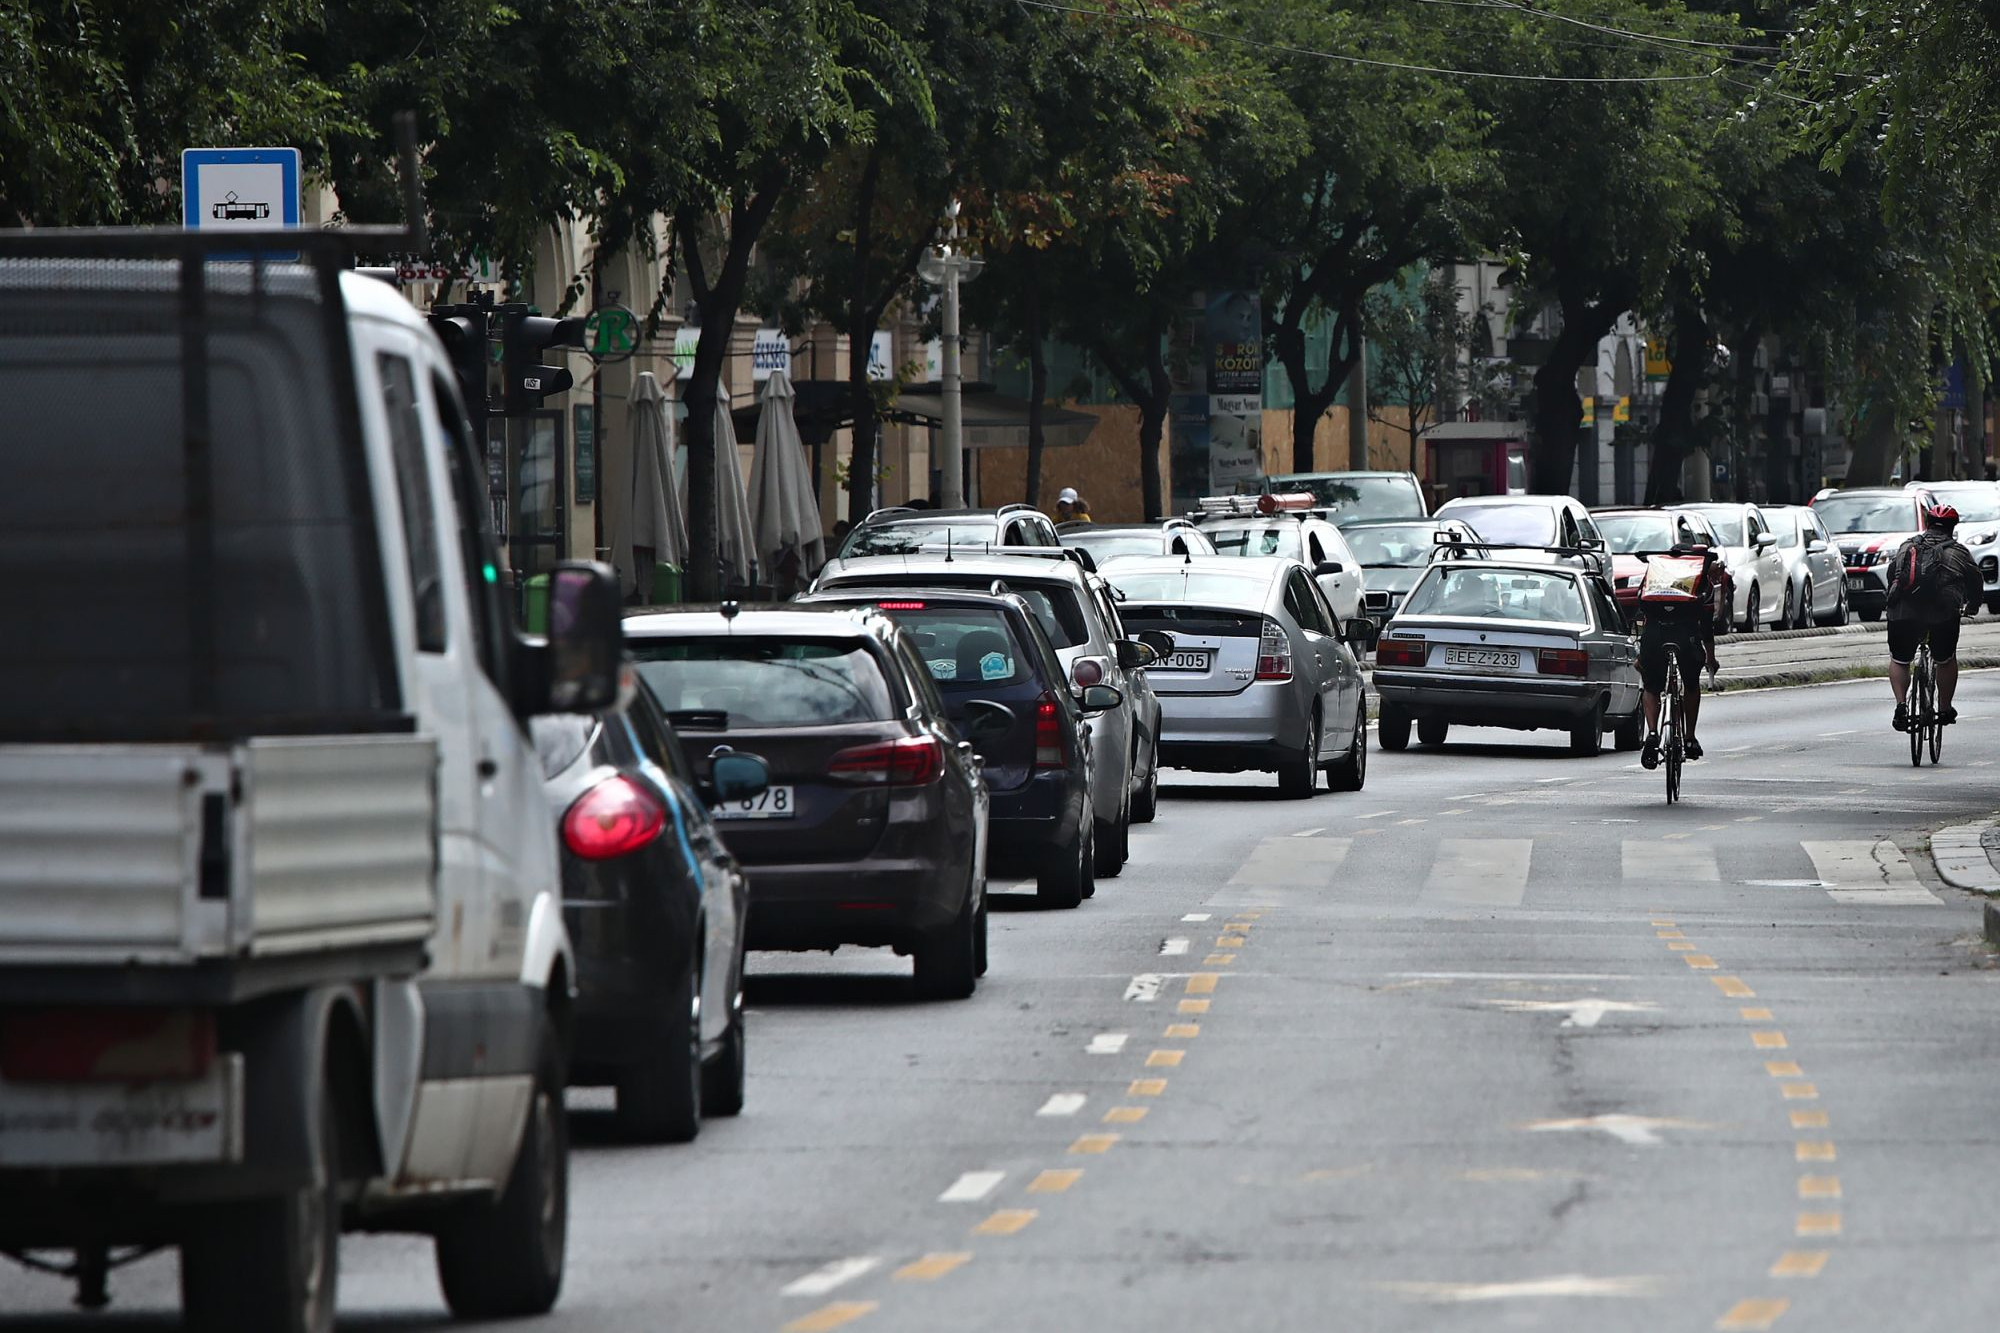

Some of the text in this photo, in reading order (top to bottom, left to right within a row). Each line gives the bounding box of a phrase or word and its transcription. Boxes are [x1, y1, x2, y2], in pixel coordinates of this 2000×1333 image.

[588, 310, 632, 353] R
[1715, 464, 1726, 478] P
[1457, 651, 1517, 666] EEZ-233
